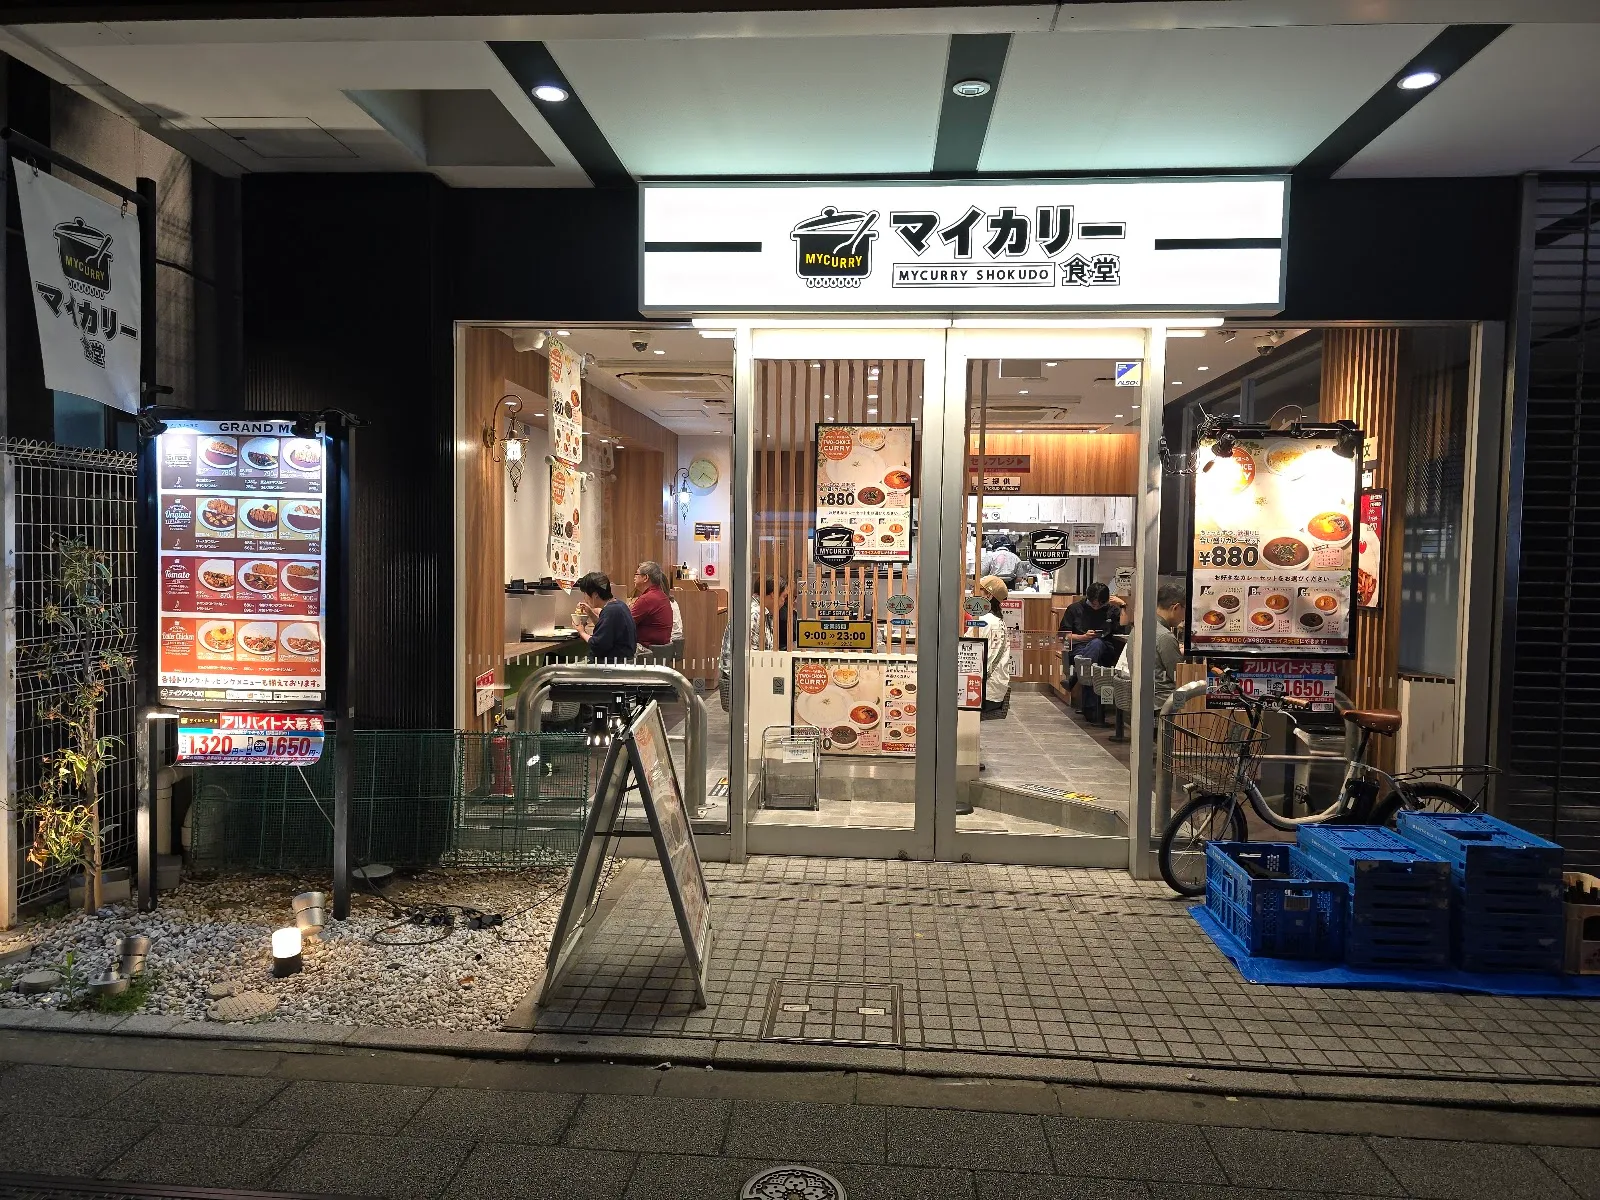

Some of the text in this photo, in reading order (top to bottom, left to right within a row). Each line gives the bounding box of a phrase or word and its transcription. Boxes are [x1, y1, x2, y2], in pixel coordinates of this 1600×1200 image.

[889, 205, 1126, 258] マイカリー
[66, 255, 105, 281] MYCURRY
[805, 252, 863, 268] MYCURRY
[898, 269, 1050, 281] MYCURRY SHOKUDO
[1060, 253, 1121, 287] 食堂
[35, 281, 138, 341] マイカリー
[219, 422, 274, 434] GRAND
[819, 492, 855, 506] ¥880
[1199, 546, 1259, 567] ¥880
[164, 570, 191, 579] Tomato
[804, 631, 866, 641] 9:00 23:00
[1244, 661, 1336, 675] アルバイト大募集
[221, 715, 324, 731] アルバイト大募集
